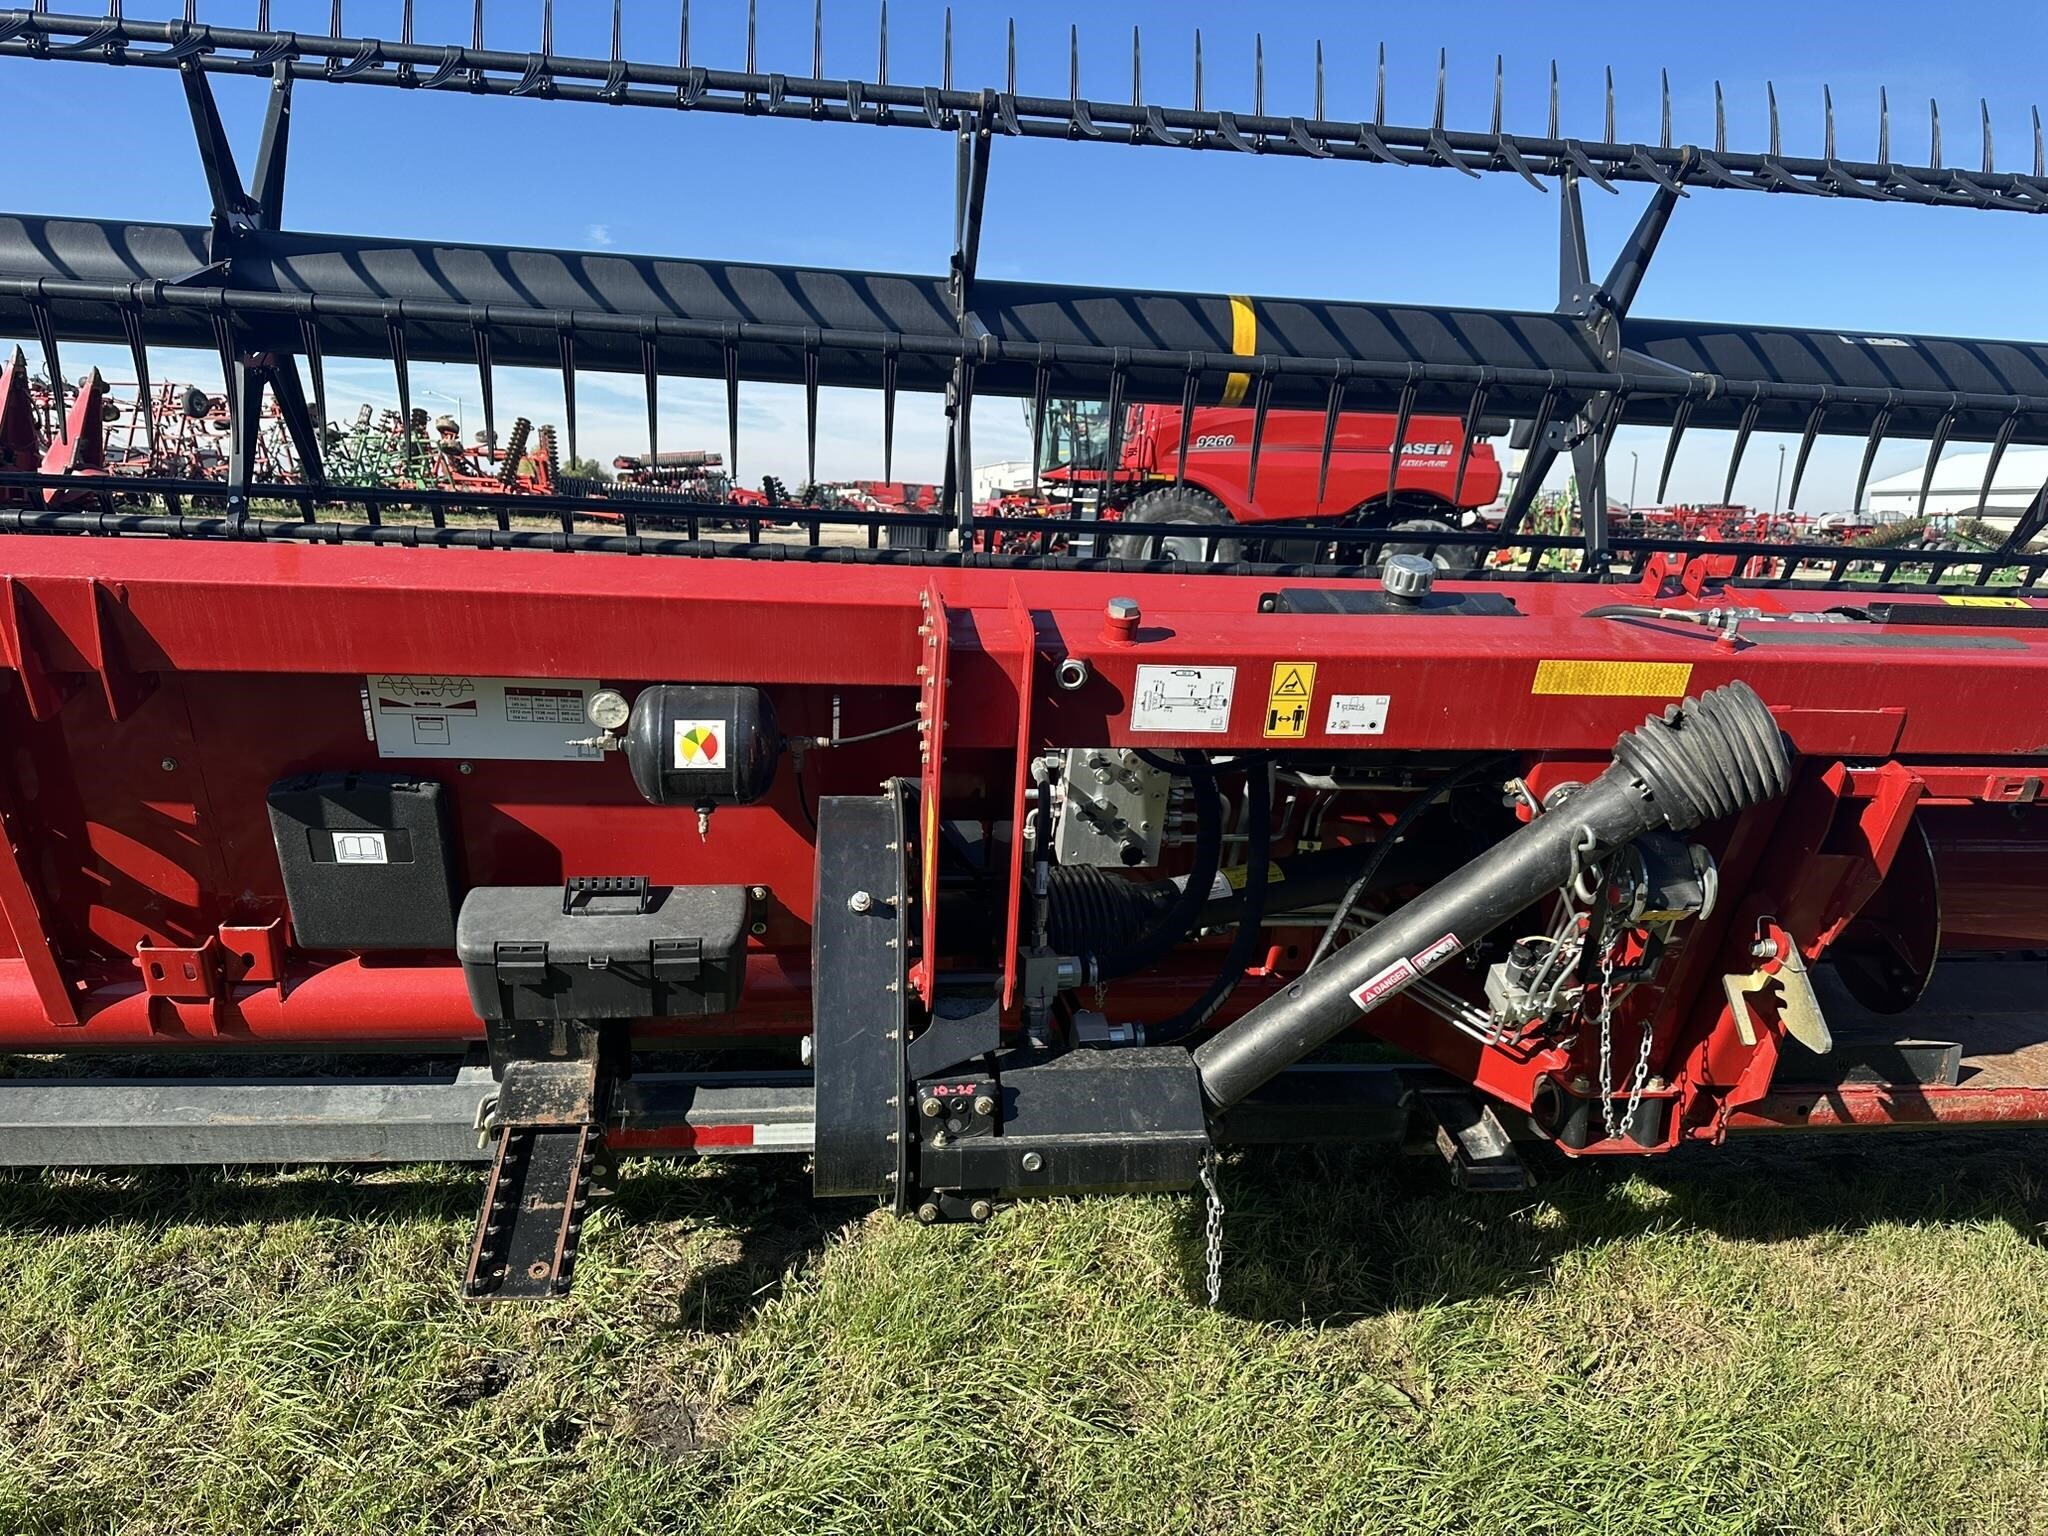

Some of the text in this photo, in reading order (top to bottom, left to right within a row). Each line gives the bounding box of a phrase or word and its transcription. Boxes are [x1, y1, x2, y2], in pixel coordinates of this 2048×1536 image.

[1197, 434, 1235, 449] 9260
[1374, 969, 1408, 995] DANGER
[933, 1084, 977, 1096] 10-25
